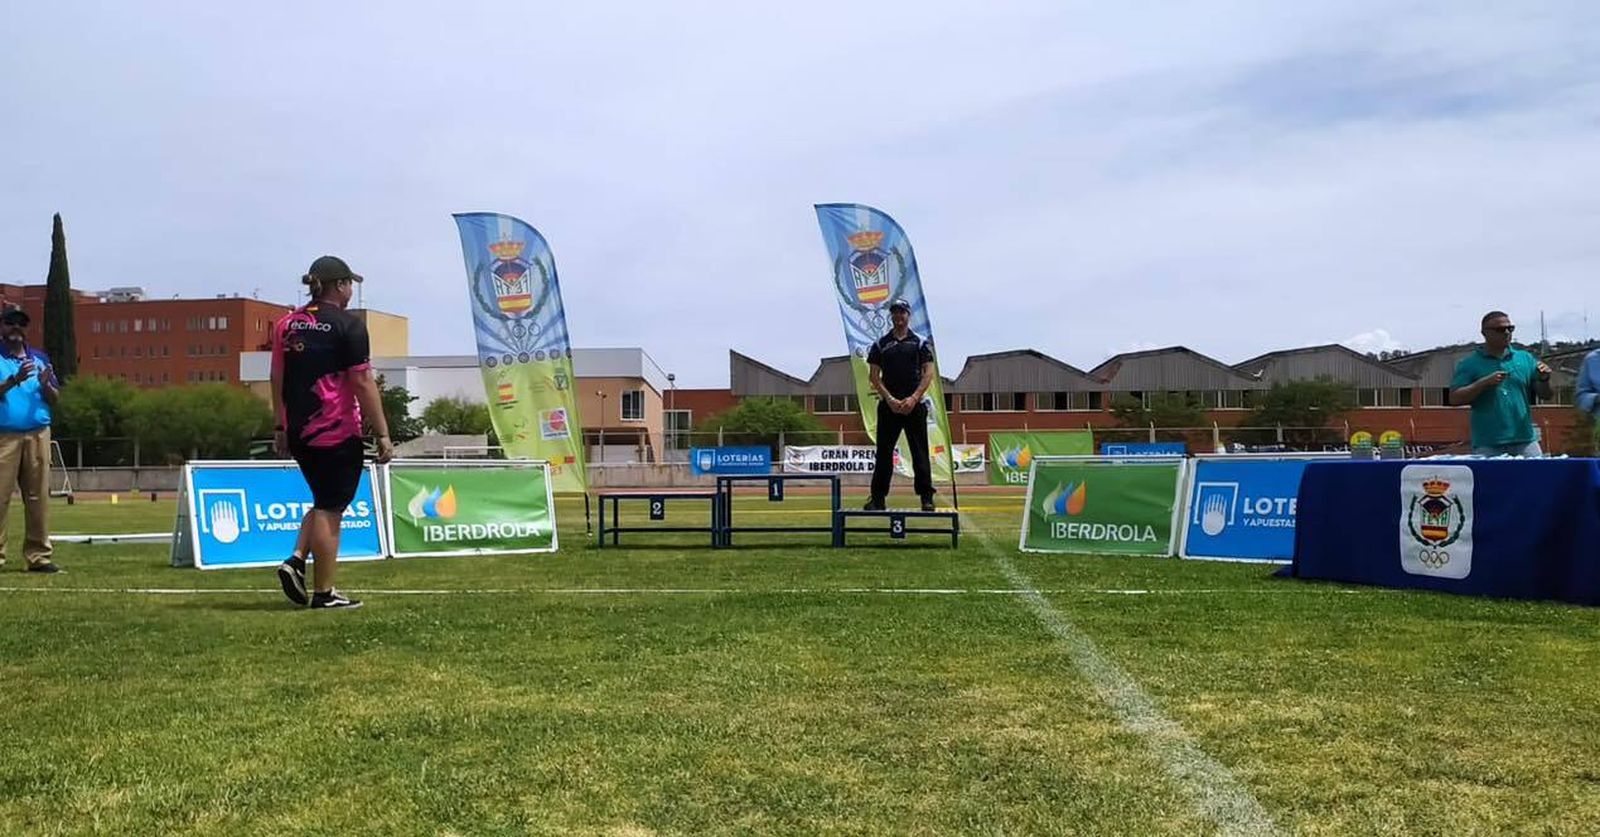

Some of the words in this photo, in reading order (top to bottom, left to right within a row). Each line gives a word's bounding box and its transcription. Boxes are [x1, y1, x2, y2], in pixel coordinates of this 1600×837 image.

[821, 449, 848, 459] GRAN
[809, 461, 864, 471] IBERDROLA
[773, 483, 779, 496] 1
[255, 501, 370, 520] LOTEAS
[652, 501, 662, 515] 2
[1243, 497, 1298, 515] LOTE
[340, 520, 371, 529] STADO
[893, 520, 903, 533] 3
[423, 523, 541, 542] IBERDROLA
[1051, 522, 1157, 542] IBERDROLA
